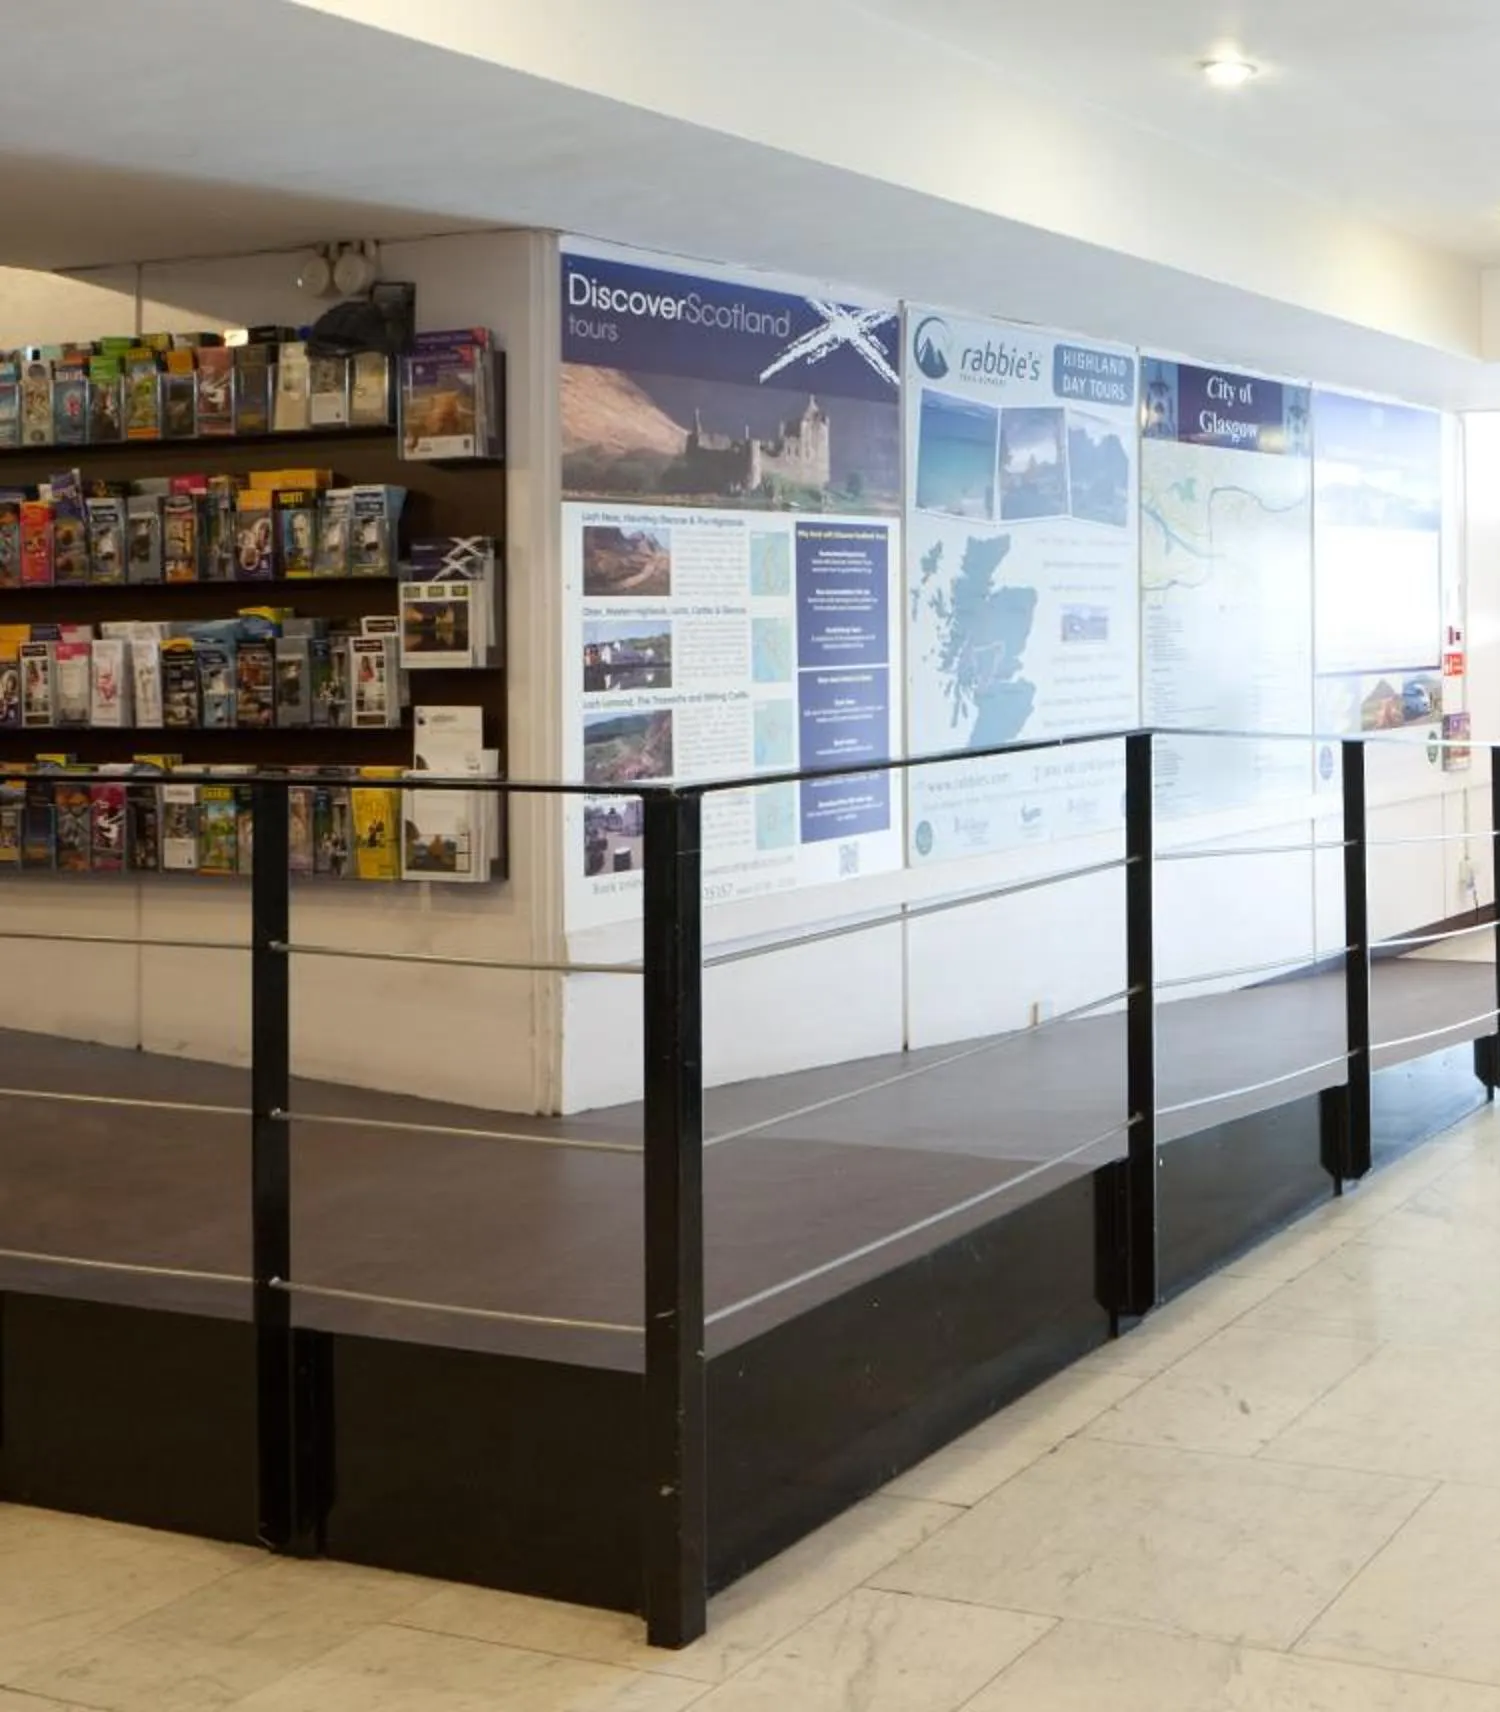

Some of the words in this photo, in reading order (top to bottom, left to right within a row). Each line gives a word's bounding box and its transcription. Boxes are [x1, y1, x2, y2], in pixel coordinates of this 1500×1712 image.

[569, 313, 619, 342] tours
[960, 339, 1042, 382] rabbie's
[1062, 349, 1128, 378] HIGHLAND
[1062, 373, 1087, 394] DAY
[1089, 378, 1129, 402] TOURS
[1206, 375, 1237, 408] City
[1239, 382, 1253, 405] of
[1199, 409, 1258, 443] Glasgow
